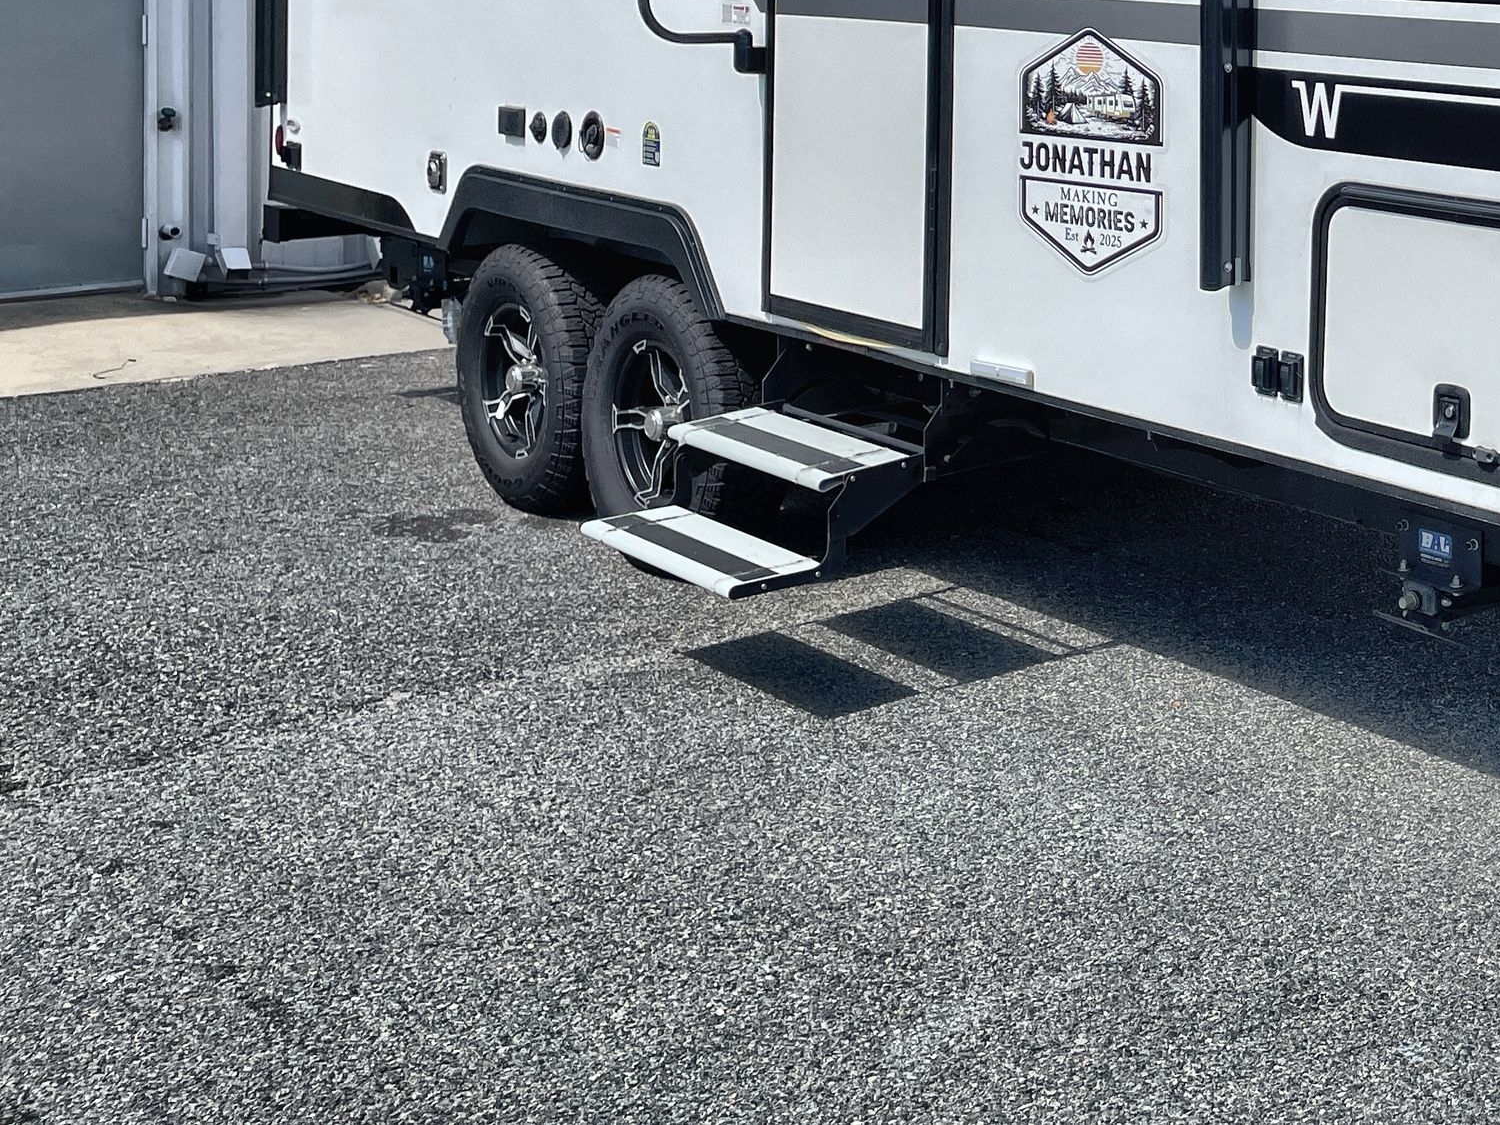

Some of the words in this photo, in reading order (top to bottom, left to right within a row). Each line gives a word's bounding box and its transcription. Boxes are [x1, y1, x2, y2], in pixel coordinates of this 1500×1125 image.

[1019, 141, 1152, 183] JONATHAN
[1060, 186, 1118, 207] MAKING
[1044, 201, 1135, 232] MEMORIES
[1065, 226, 1079, 242] Est
[1099, 233, 1122, 248] 2025
